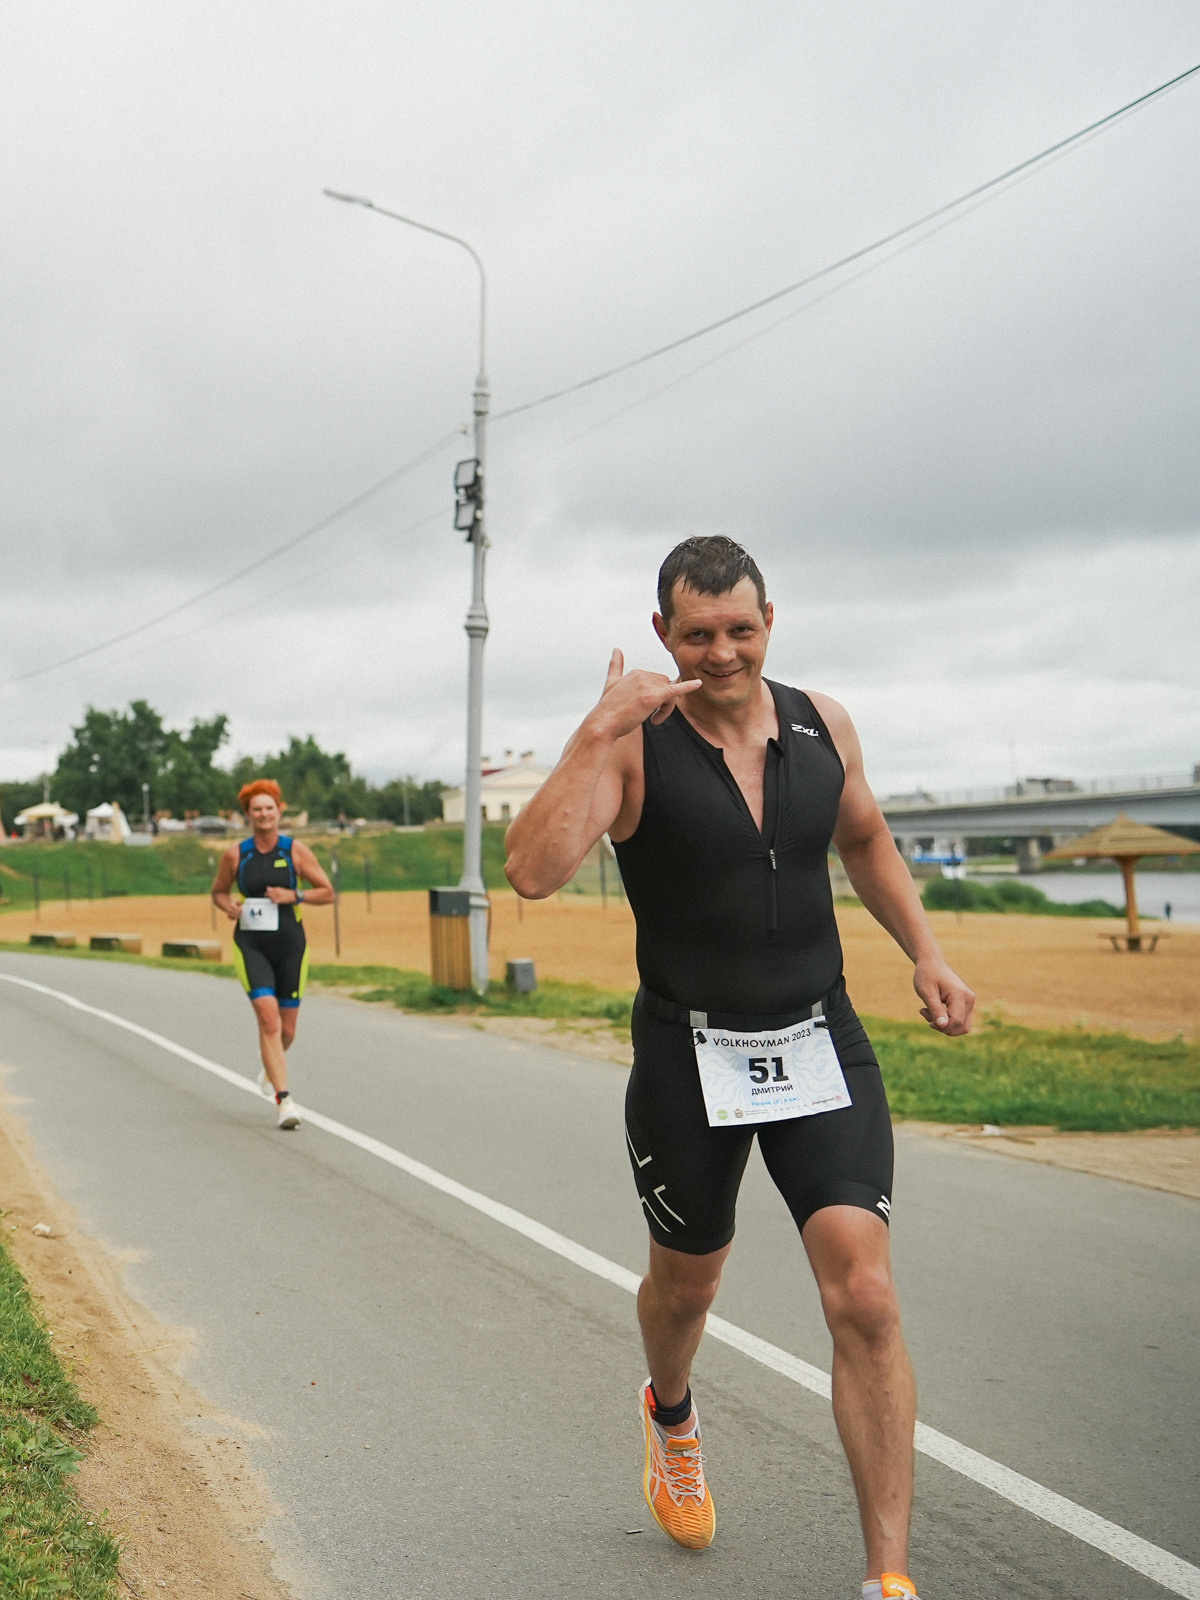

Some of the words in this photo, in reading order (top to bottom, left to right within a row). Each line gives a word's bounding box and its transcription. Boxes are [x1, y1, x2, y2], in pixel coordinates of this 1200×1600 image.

[712, 1036, 790, 1048] VOLKHOVMAN
[791, 1028, 811, 1042] 2023
[748, 1056, 789, 1084] 51
[751, 1084, 794, 1096] ДМИТРИЙ
